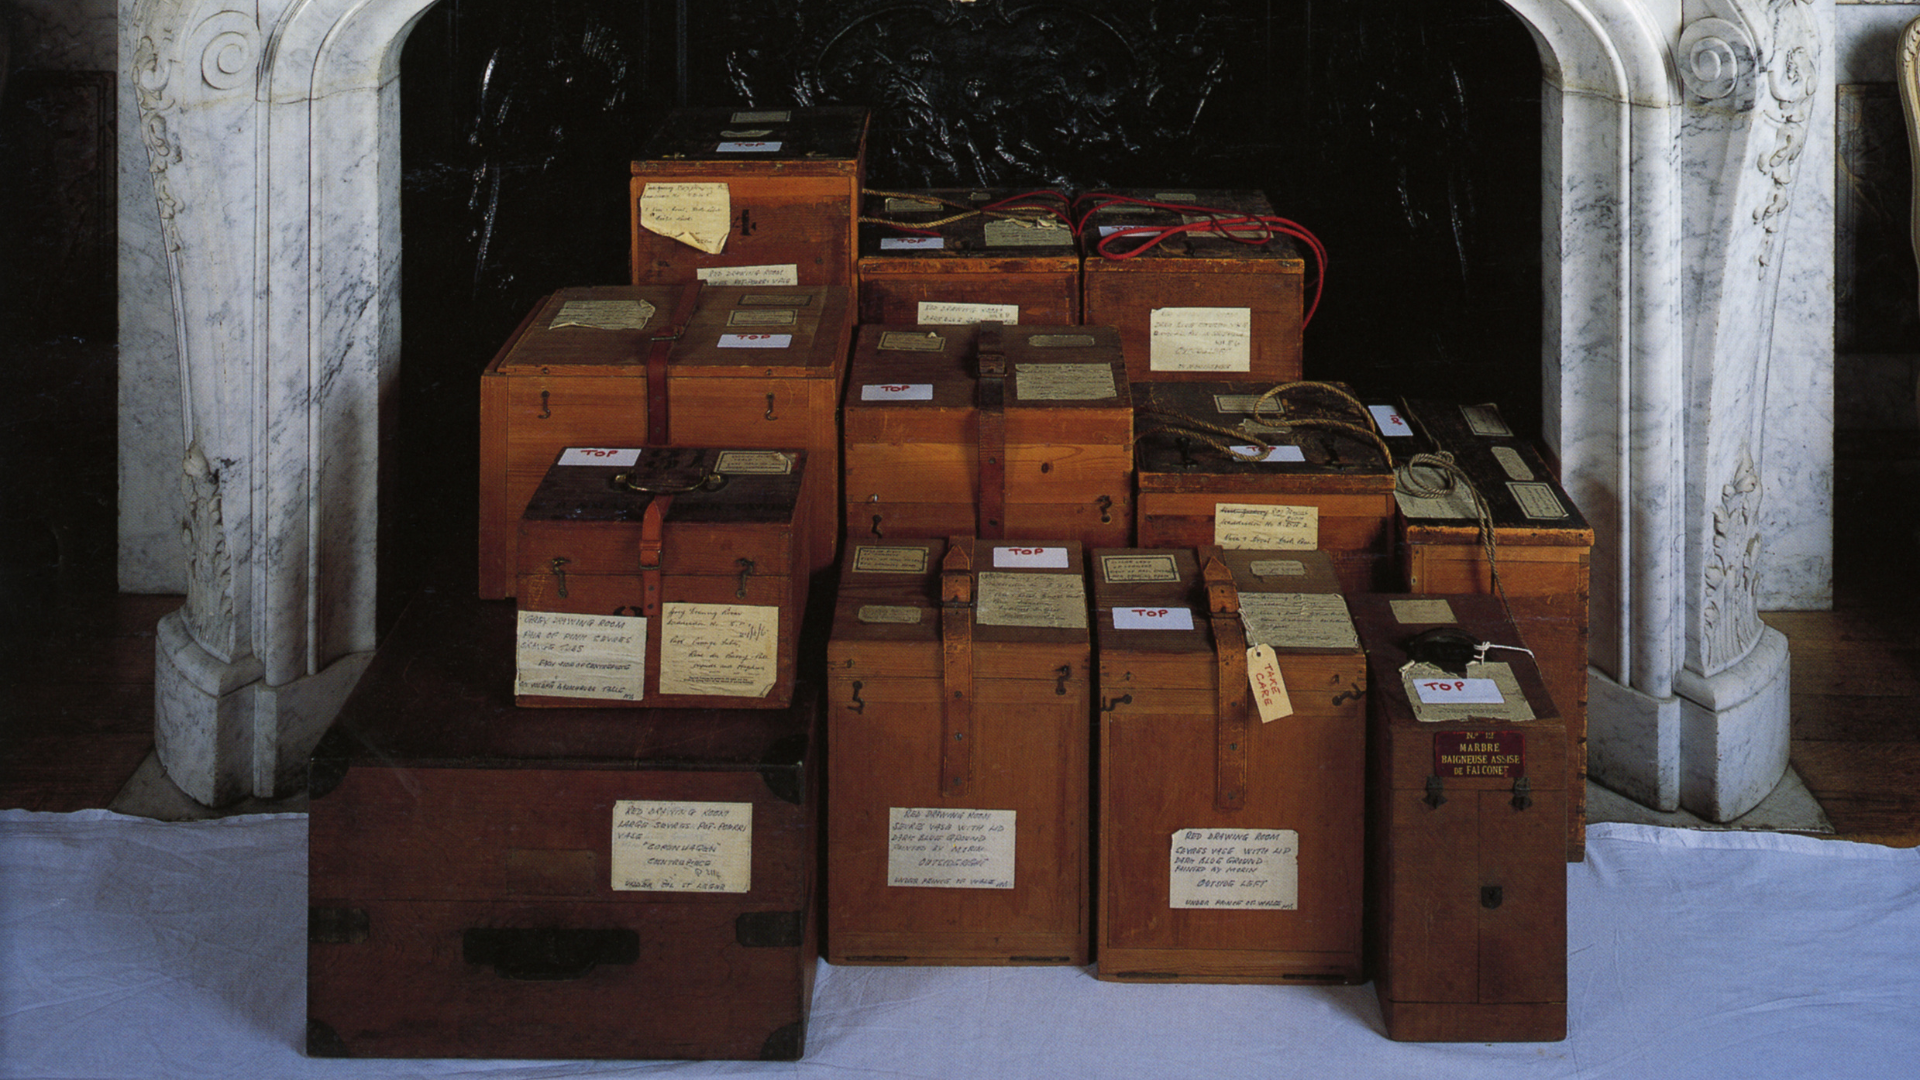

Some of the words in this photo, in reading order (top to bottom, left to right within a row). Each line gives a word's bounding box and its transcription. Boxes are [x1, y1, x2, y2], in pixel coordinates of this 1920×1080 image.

[580, 449, 619, 458] TOP
[1131, 609, 1168, 617] TOP
[598, 618, 626, 629] ROOM
[1264, 663, 1281, 695] TAKE
[1256, 672, 1273, 706] CARE
[1424, 681, 1465, 691] TOP
[1460, 742, 1500, 752] MARBRE
[1441, 755, 1488, 764] BAIGNEUSE
[1491, 755, 1520, 764] ASSISE
[1454, 767, 1463, 775] DE
[625, 807, 643, 815] RED
[904, 809, 921, 818] RED
[1185, 831, 1202, 840] RED
[1207, 832, 1249, 841] DRAWING
[1254, 832, 1280, 841] ROOM
[1211, 847, 1235, 855] VASE
[1272, 847, 1291, 855] LID
[1225, 856, 1263, 865] GROUND
[1197, 878, 1235, 888] OUTSIDE
[1240, 879, 1268, 888] LEFT
